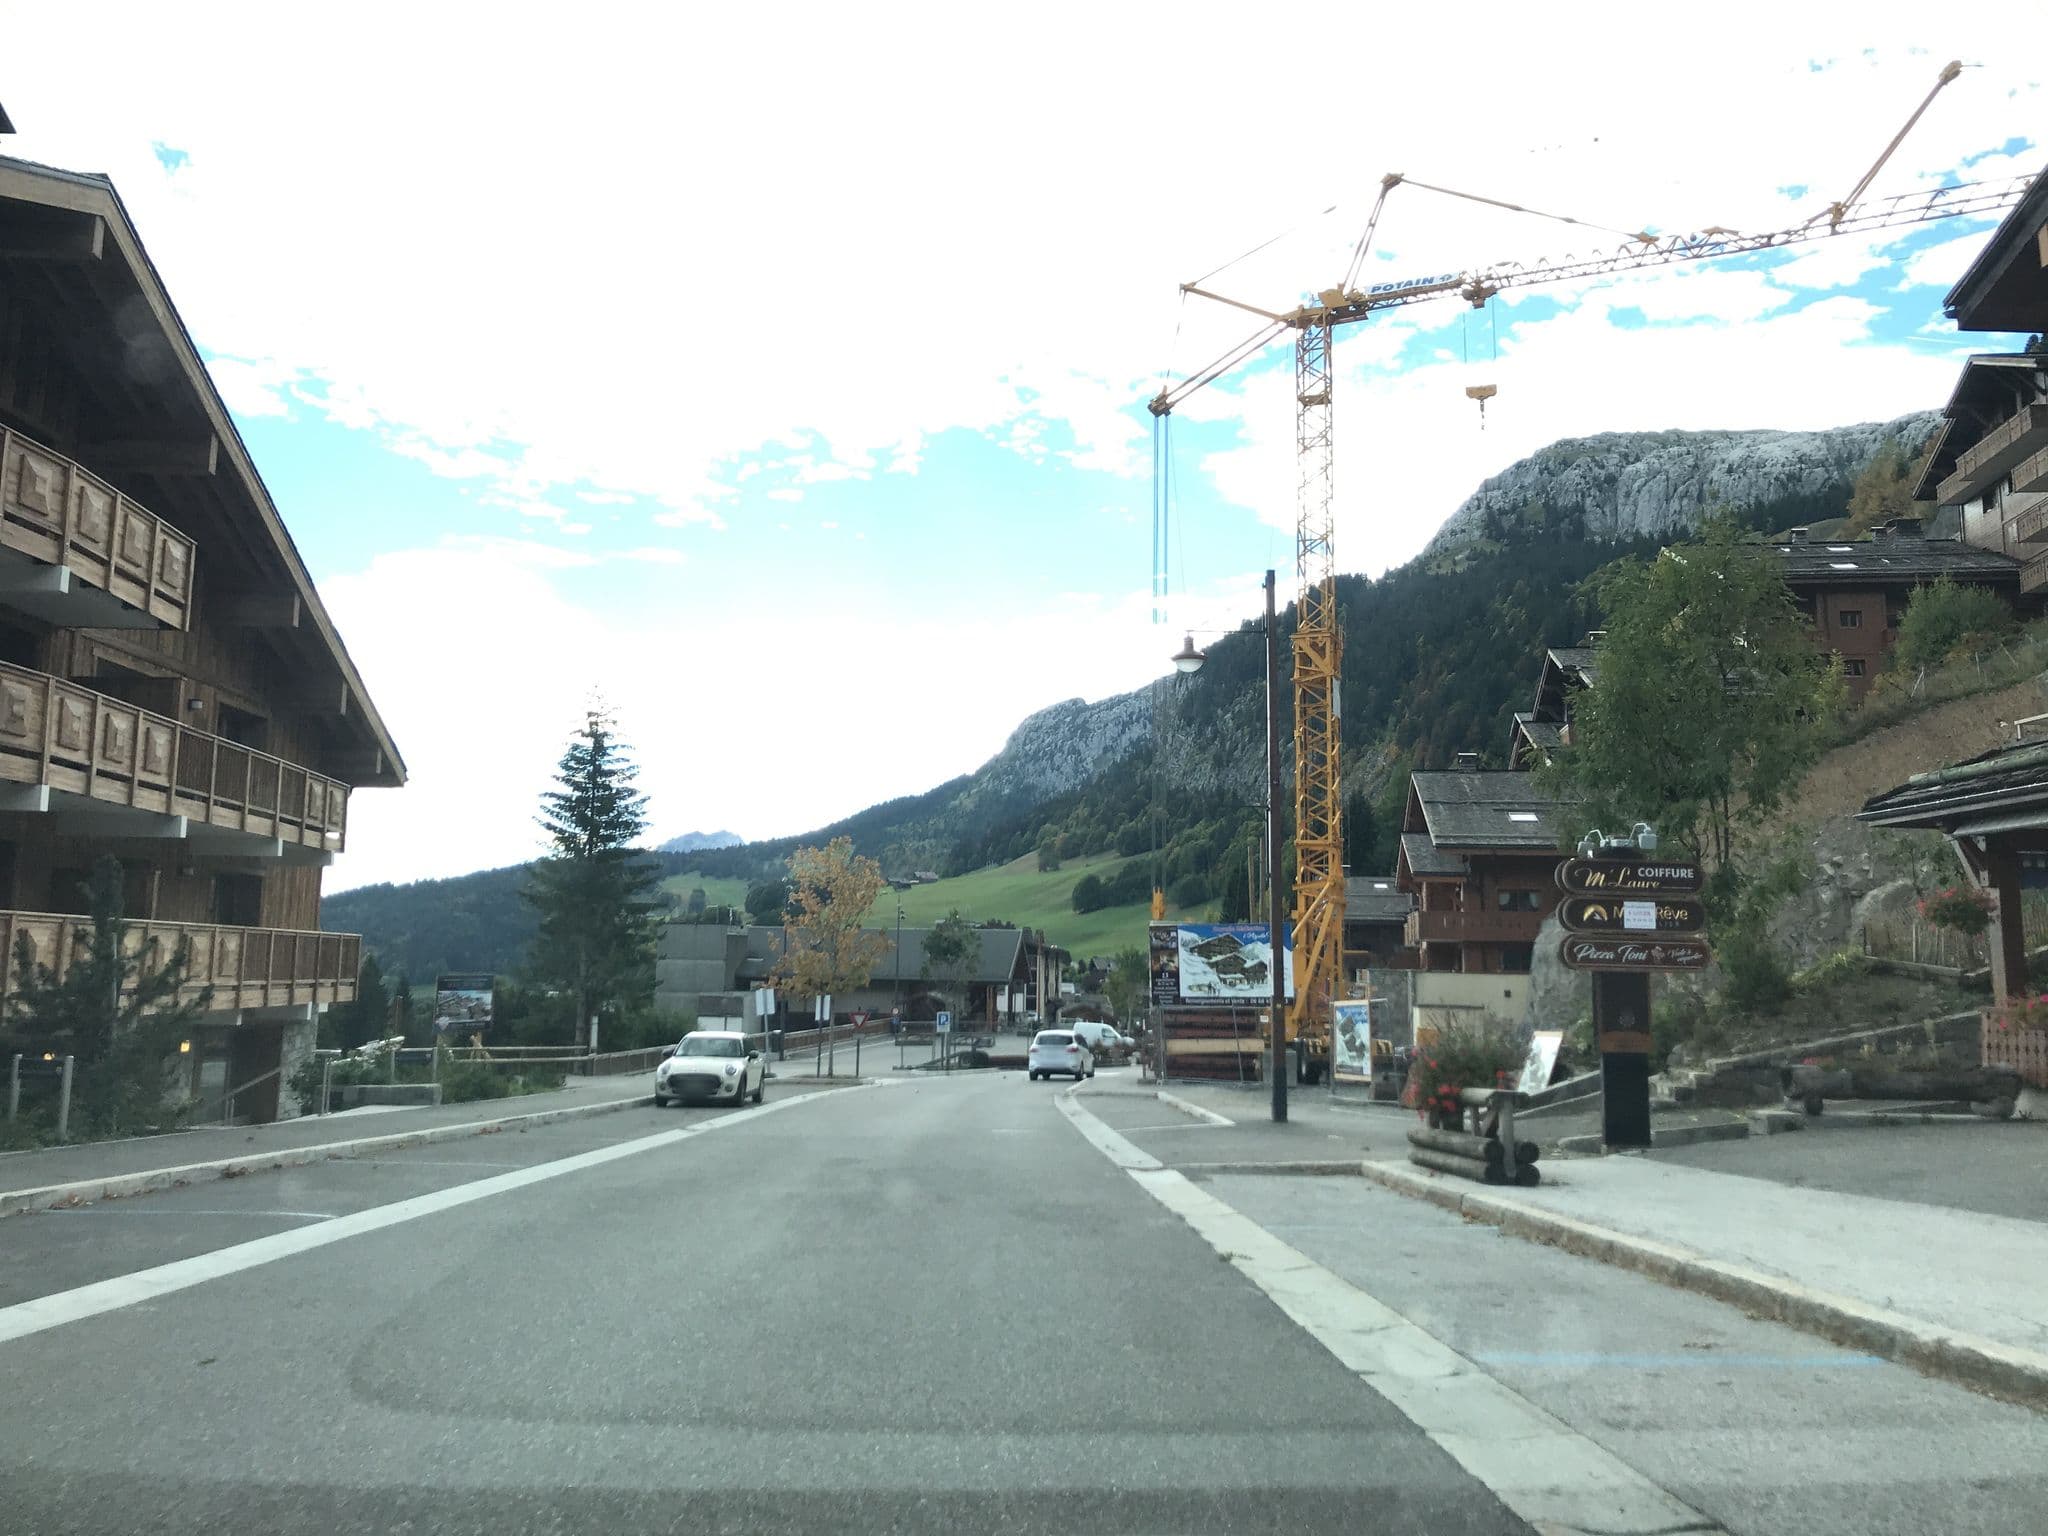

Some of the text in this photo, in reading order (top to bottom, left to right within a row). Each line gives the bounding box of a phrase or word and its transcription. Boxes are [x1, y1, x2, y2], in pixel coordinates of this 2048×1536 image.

[1371, 276, 1435, 294] POTAIN
[1637, 867, 1694, 879] COIFFURE
[1655, 906, 1688, 920] Rêve
[1573, 943, 1616, 962] Pizza
[1617, 944, 1649, 963] Toni
[940, 1015, 947, 1025] P
